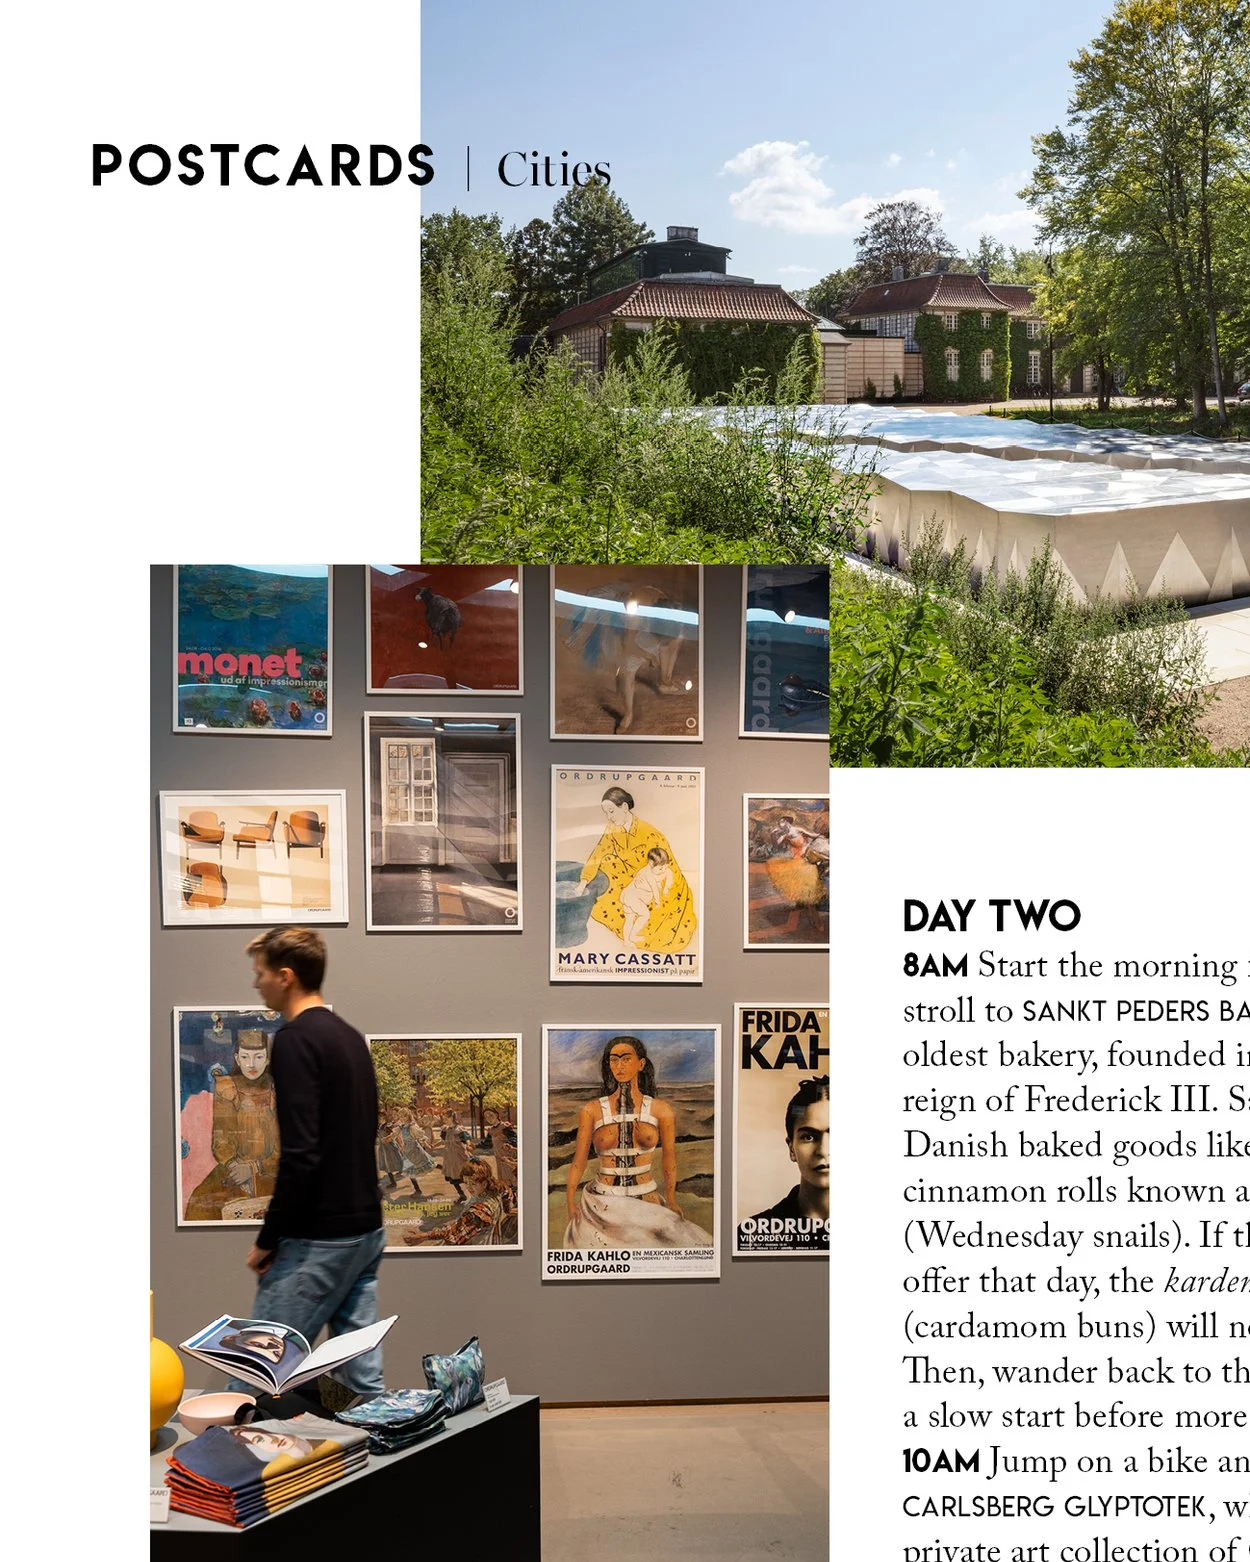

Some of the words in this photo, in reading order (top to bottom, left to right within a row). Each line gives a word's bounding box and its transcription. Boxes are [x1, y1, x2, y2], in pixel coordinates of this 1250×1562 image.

[93, 144, 434, 185] POSTCARDS
[499, 151, 610, 188] Cities
[178, 648, 302, 678] monet
[221, 676, 233, 684] ud
[236, 676, 246, 684] af
[559, 772, 697, 781] ORDRUPGAARD
[904, 899, 976, 931] DAY
[989, 899, 1081, 931] TWO
[558, 952, 609, 965] MARY
[615, 953, 696, 965] CASSATT
[903, 952, 967, 977] 8AM
[979, 950, 1047, 977] Start
[1058, 951, 1102, 977] the
[1114, 953, 1238, 986] morning
[904, 996, 975, 1022] stroll
[985, 1003, 1013, 1022] to
[1024, 1000, 1107, 1021] SANKT
[1118, 1000, 1209, 1021] PEDERS
[742, 1010, 821, 1033] FRIDA
[408, 1201, 452, 1211] Hansen
[796, 1234, 810, 1242] 110
[547, 1251, 583, 1262] FRIDA
[588, 1250, 631, 1261] KAHLO
[547, 1264, 631, 1274] ORDRUPGAARD
